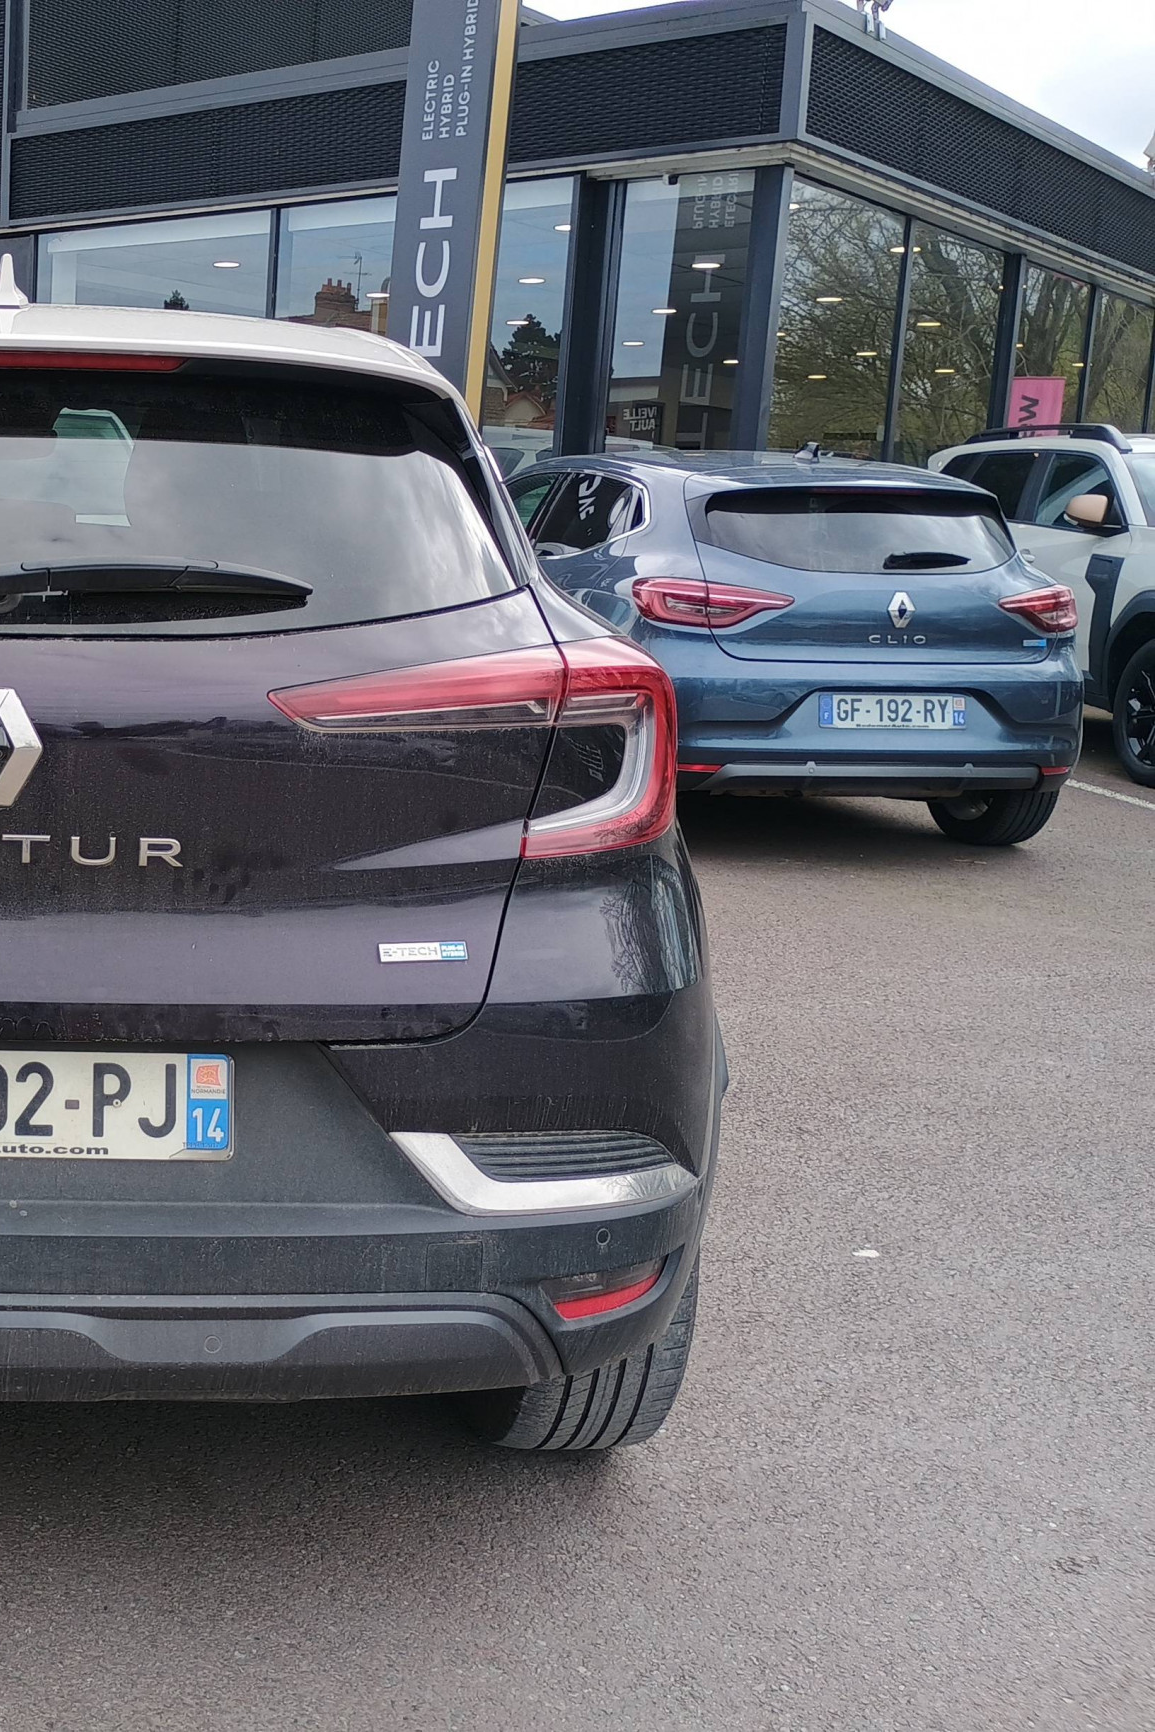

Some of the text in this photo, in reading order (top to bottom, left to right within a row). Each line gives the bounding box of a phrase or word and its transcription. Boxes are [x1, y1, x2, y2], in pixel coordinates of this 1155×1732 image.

[421, 60, 440, 140] ELECTRIC
[439, 74, 455, 138] HYBRID
[455, 65, 473, 136] PLUG-IN
[868, 634, 927, 645] CLIO
[836, 697, 949, 723] GF-192-RY
[953, 712, 965, 725] 14
[382, 946, 439, 957] E-TECH
[192, 1107, 225, 1143] 14
